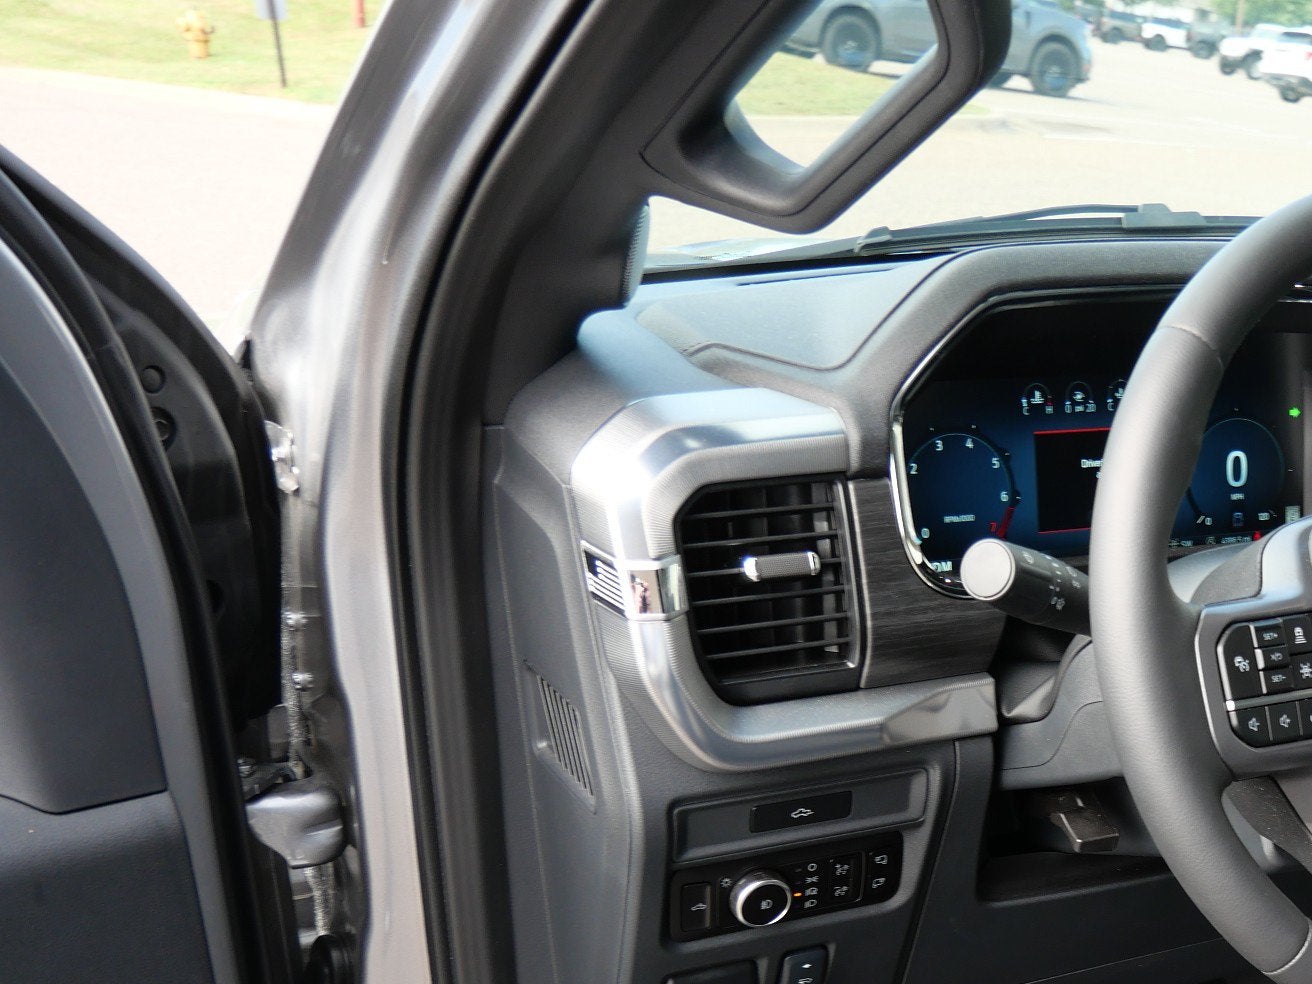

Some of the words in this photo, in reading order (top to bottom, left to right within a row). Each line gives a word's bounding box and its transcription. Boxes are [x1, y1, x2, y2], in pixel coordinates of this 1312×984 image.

[935, 440, 944, 451] 3
[965, 438, 974, 449] 4
[909, 463, 918, 475] 2
[991, 457, 1001, 469] 5
[1226, 450, 1248, 487] 0
[1000, 491, 1009, 502] 6
[920, 527, 930, 539] 0
